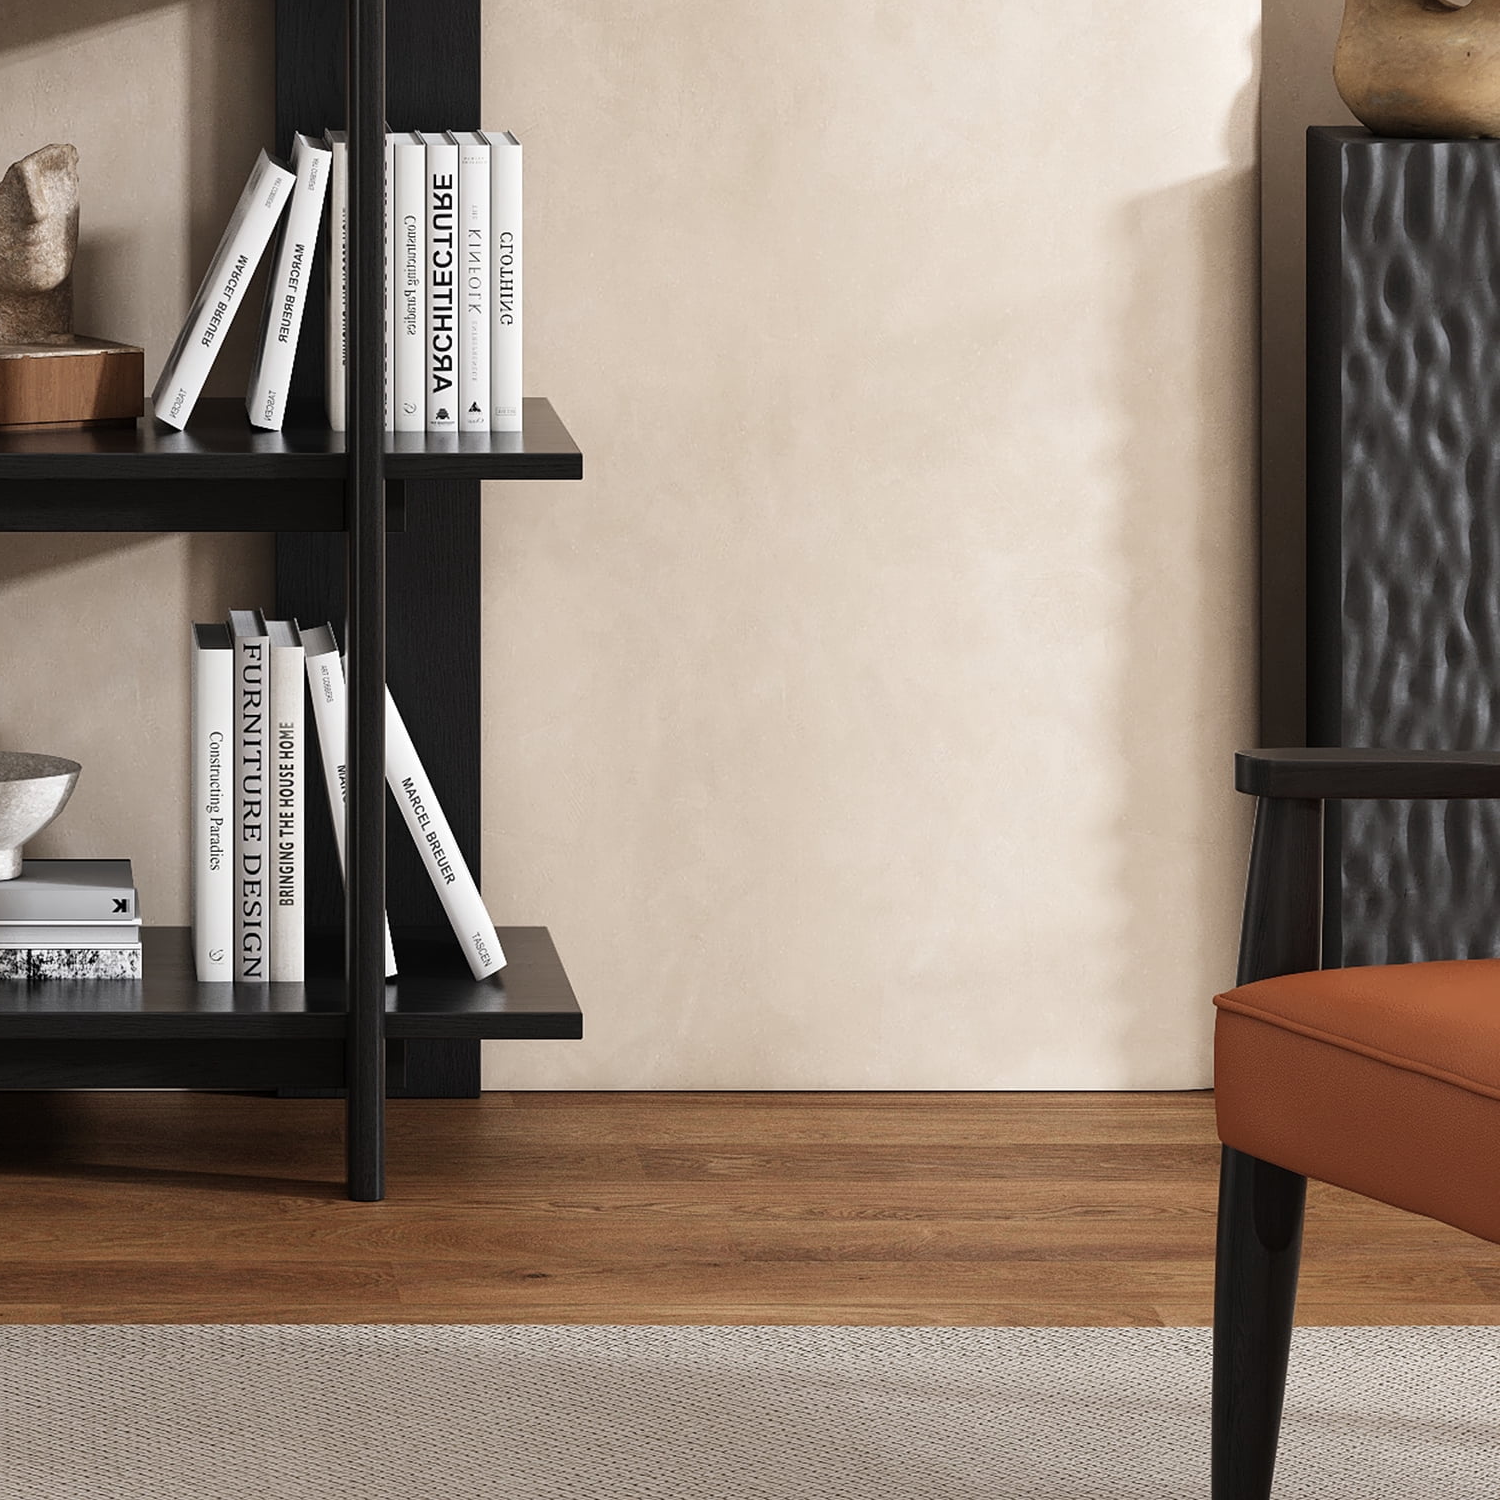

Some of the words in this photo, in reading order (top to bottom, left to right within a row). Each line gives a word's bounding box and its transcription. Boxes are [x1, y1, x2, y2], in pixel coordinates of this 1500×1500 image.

[243, 643, 262, 842] FURNITURE
[279, 722, 294, 760] HOME
[206, 731, 224, 813] Constructing
[279, 762, 294, 809] HOUSE
[210, 816, 224, 871] Paradies
[279, 811, 294, 839] THE
[401, 776, 429, 833] MARCEL
[426, 832, 456, 886] BREUER
[279, 842, 294, 906] BRINGING
[243, 855, 262, 979] DESIGN
[471, 931, 493, 968] TASCEN
